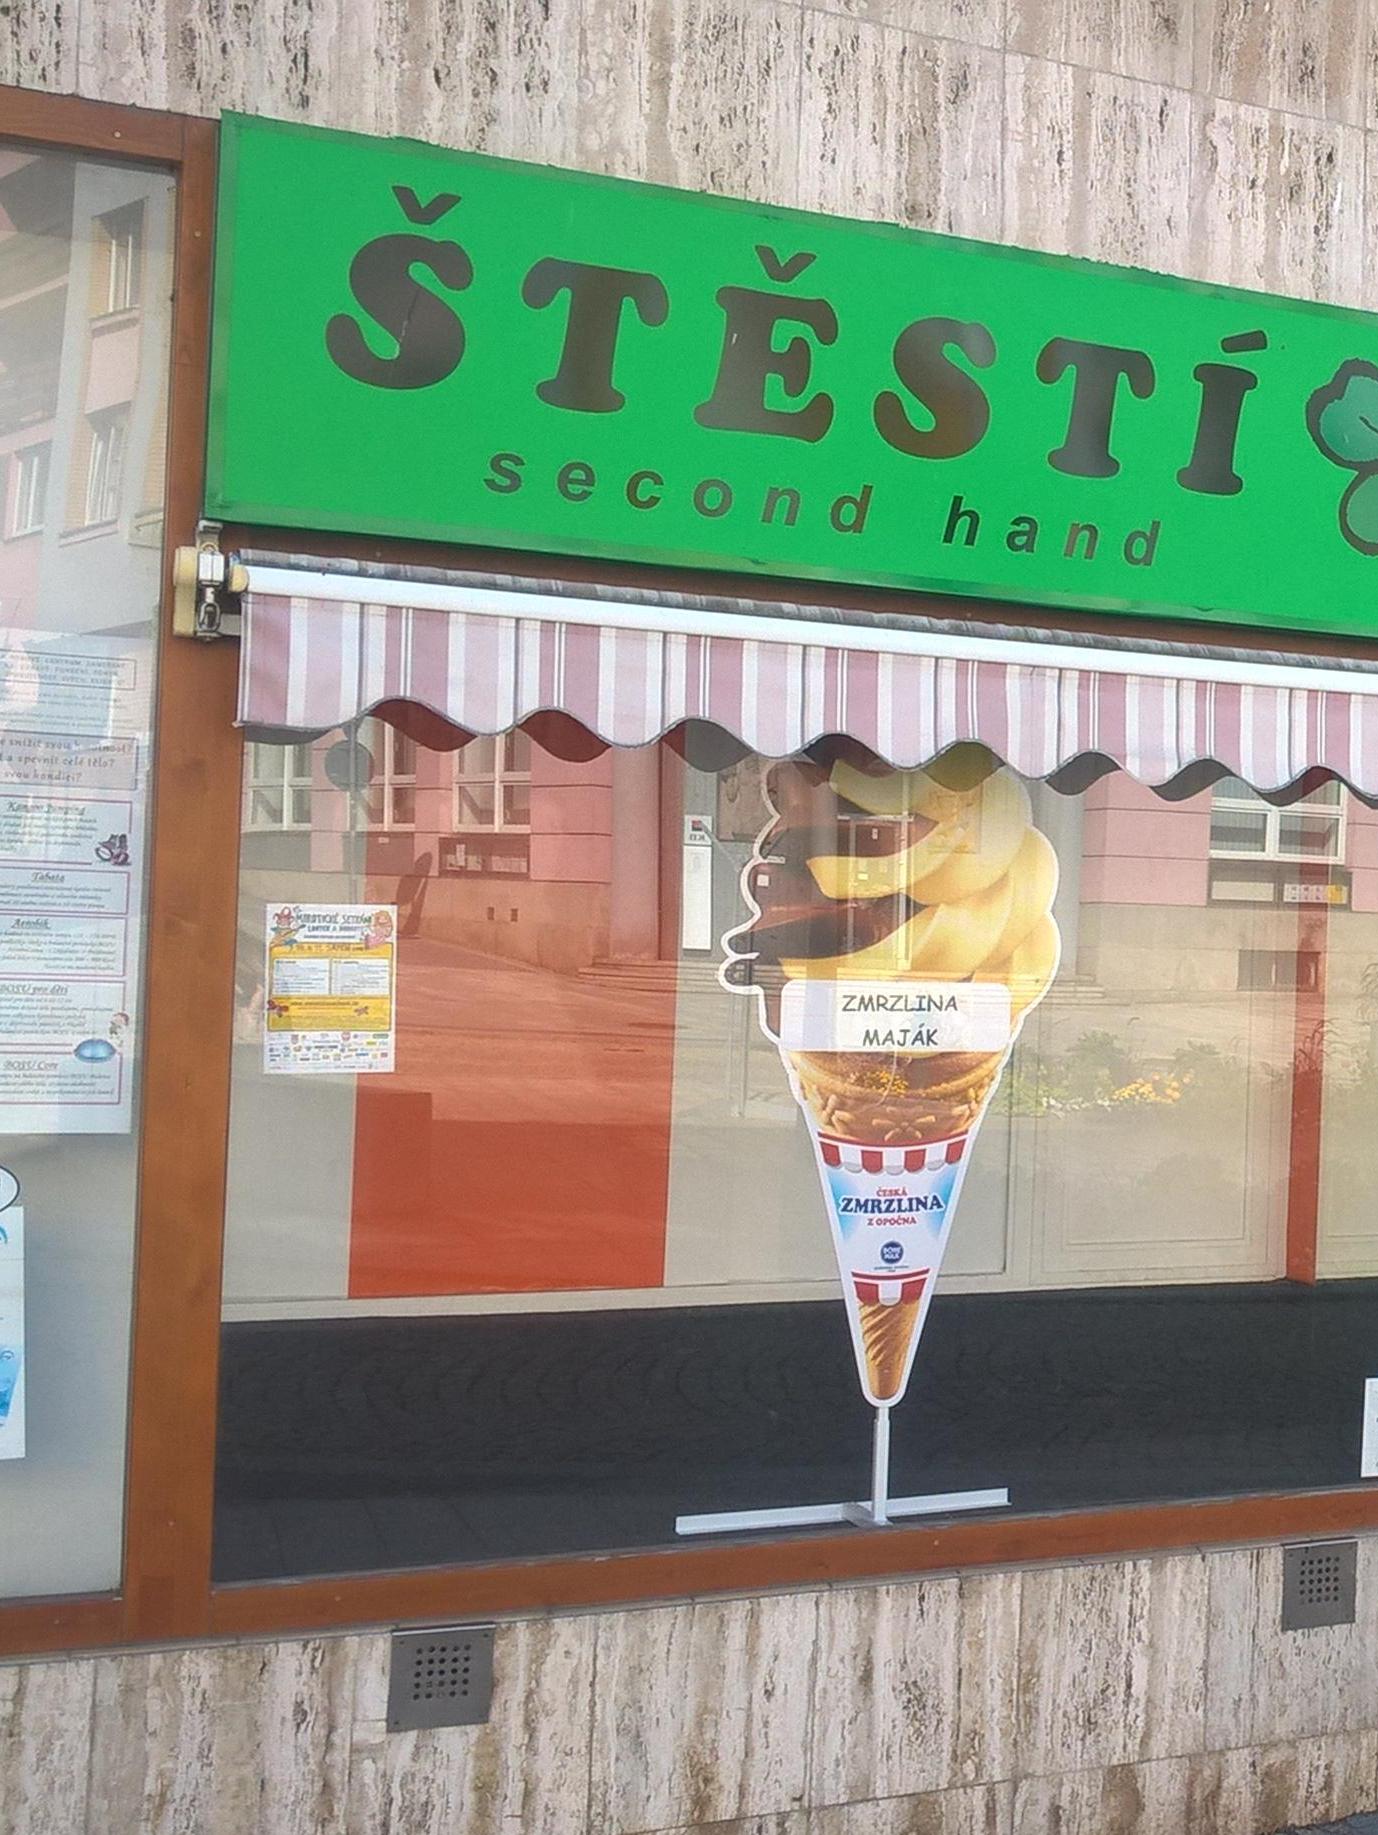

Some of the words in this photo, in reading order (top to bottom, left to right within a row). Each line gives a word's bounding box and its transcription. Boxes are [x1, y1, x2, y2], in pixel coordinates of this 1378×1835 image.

[325, 185, 1268, 496] ŠTĚSTÍ
[483, 452, 873, 534] second
[942, 497, 1161, 567] hand
[841, 994, 958, 1012] ZMRZLINA
[863, 1023, 938, 1047] MAJÁK
[876, 1187, 908, 1197] ČESKÁ
[840, 1194, 944, 1214] ZMRZLINA
[876, 1215, 917, 1226] OPOČNA
